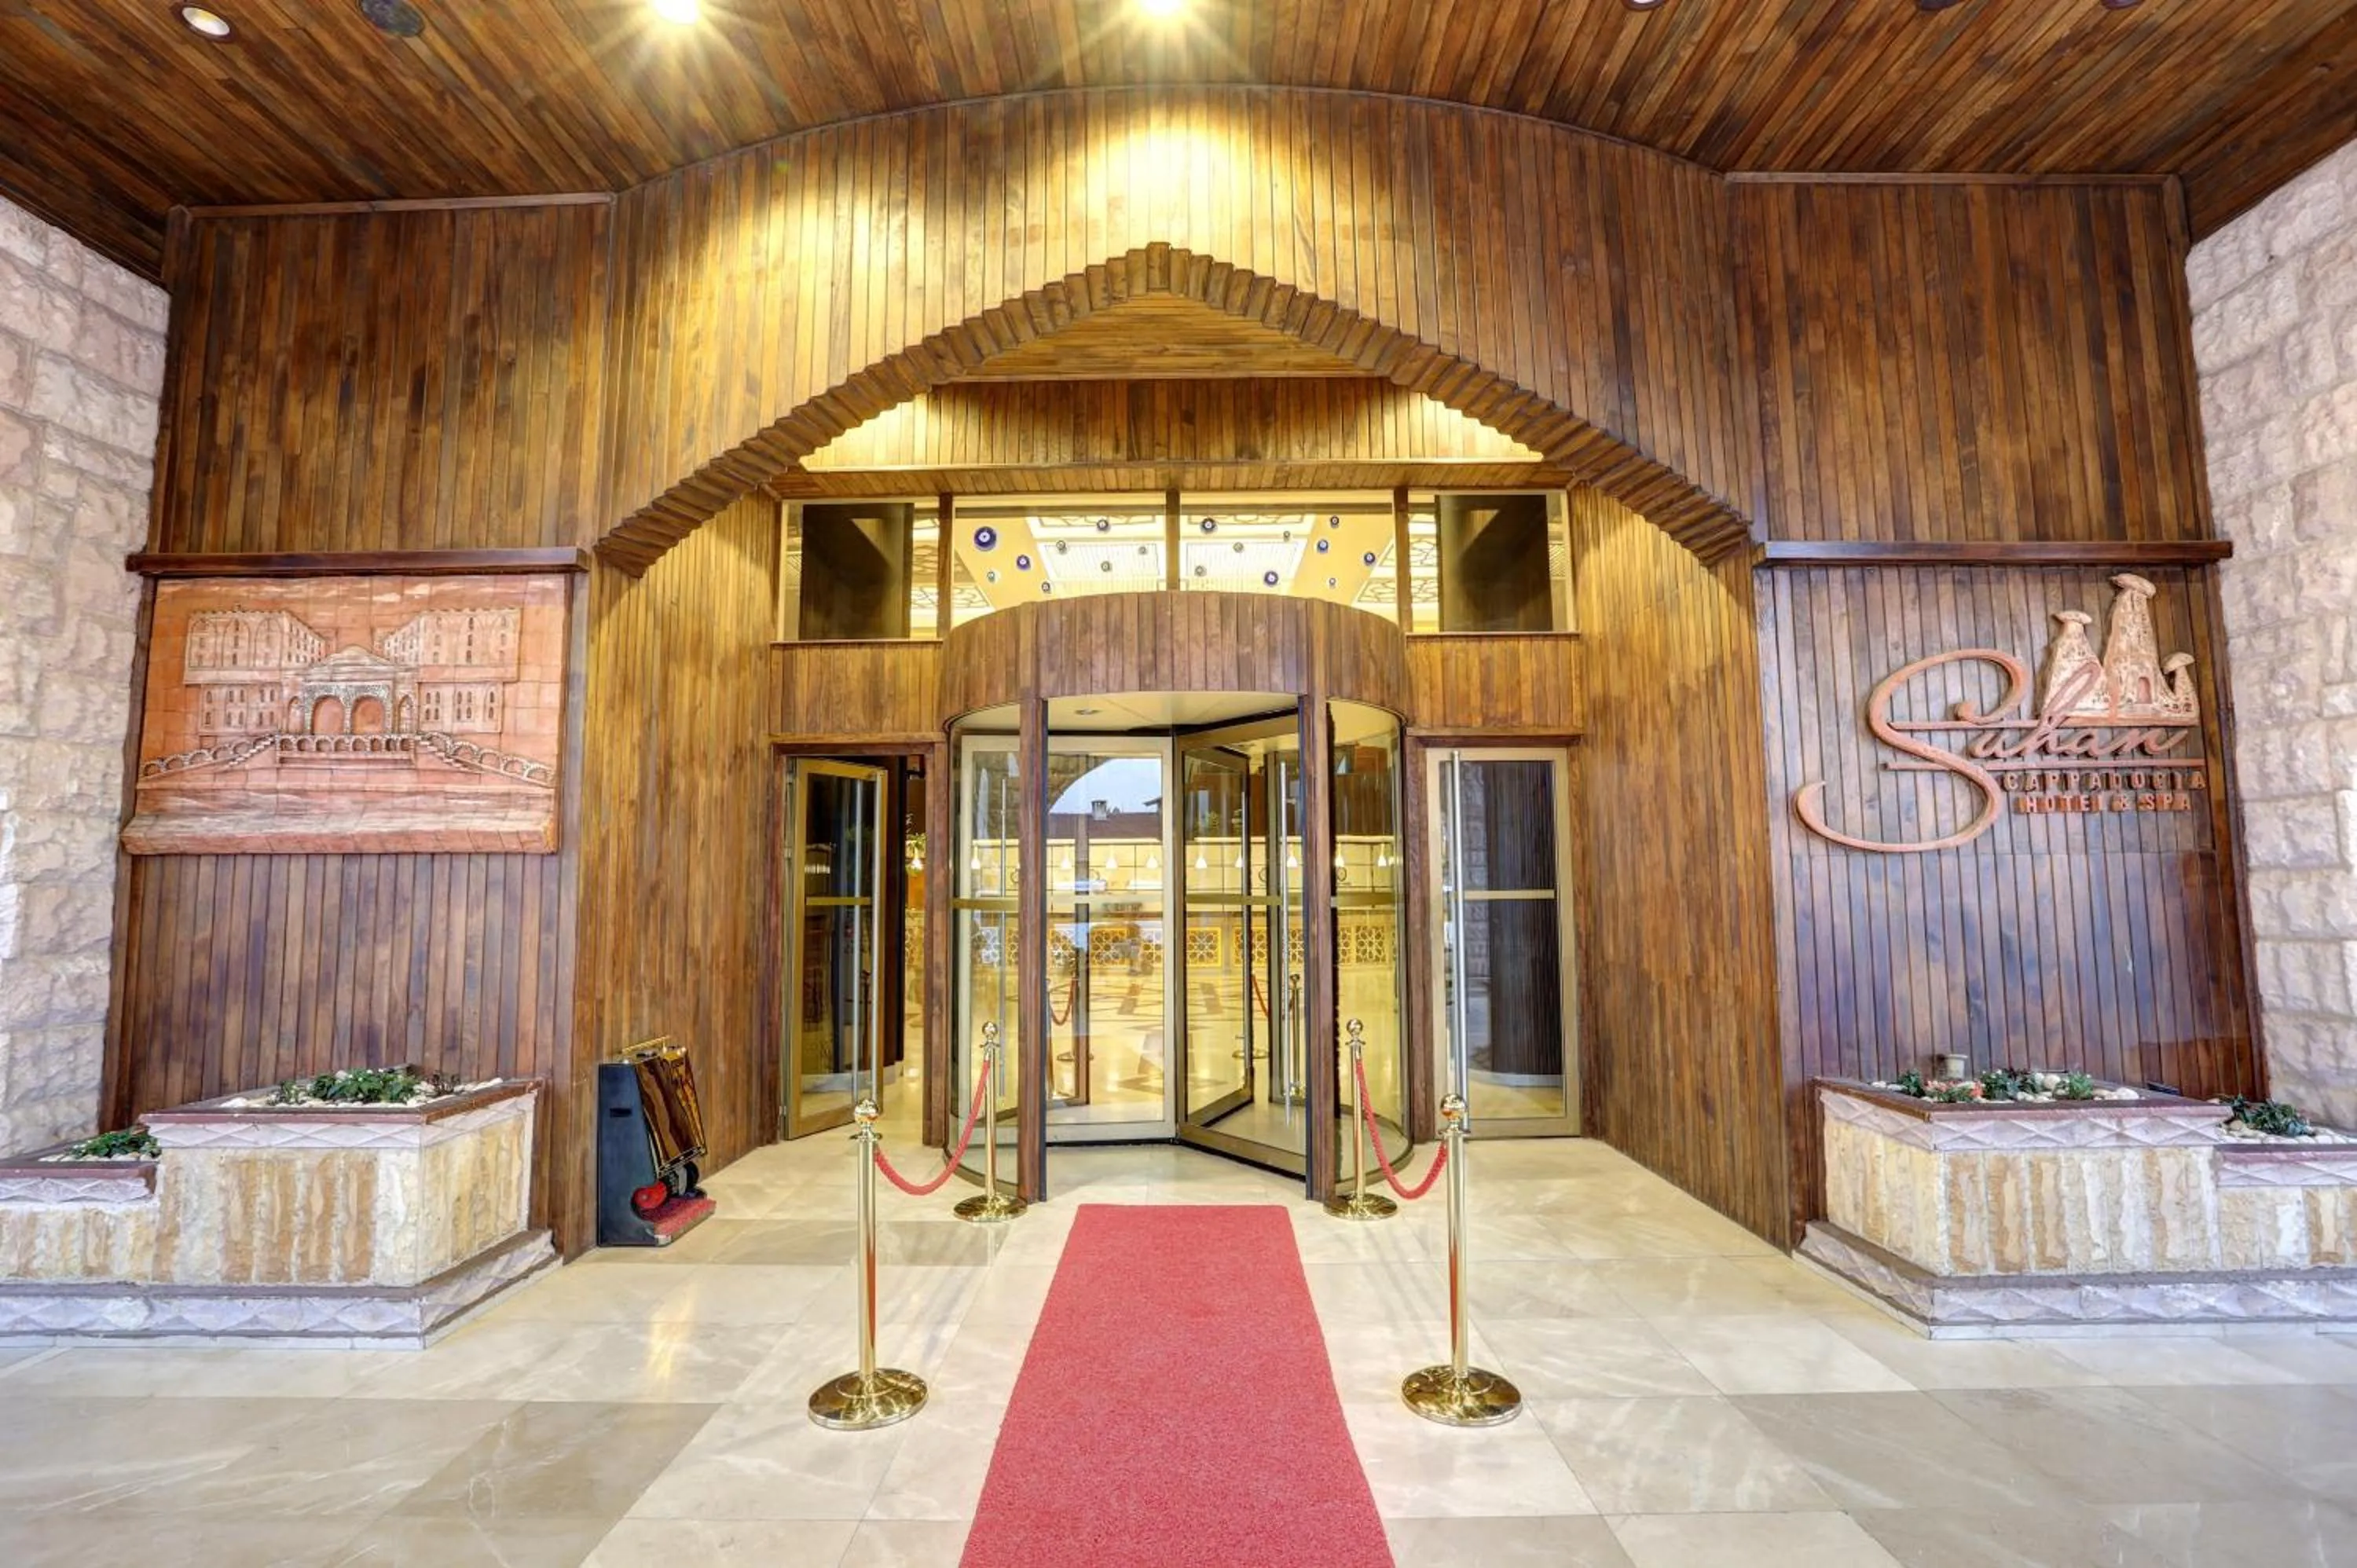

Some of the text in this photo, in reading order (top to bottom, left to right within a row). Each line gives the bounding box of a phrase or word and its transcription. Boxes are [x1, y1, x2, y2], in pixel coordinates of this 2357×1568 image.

[1793, 648, 2189, 853] Suhan
[2003, 771, 2207, 792] CAPPADOCIA
[2019, 793, 2190, 814] HOTEL & SPA
